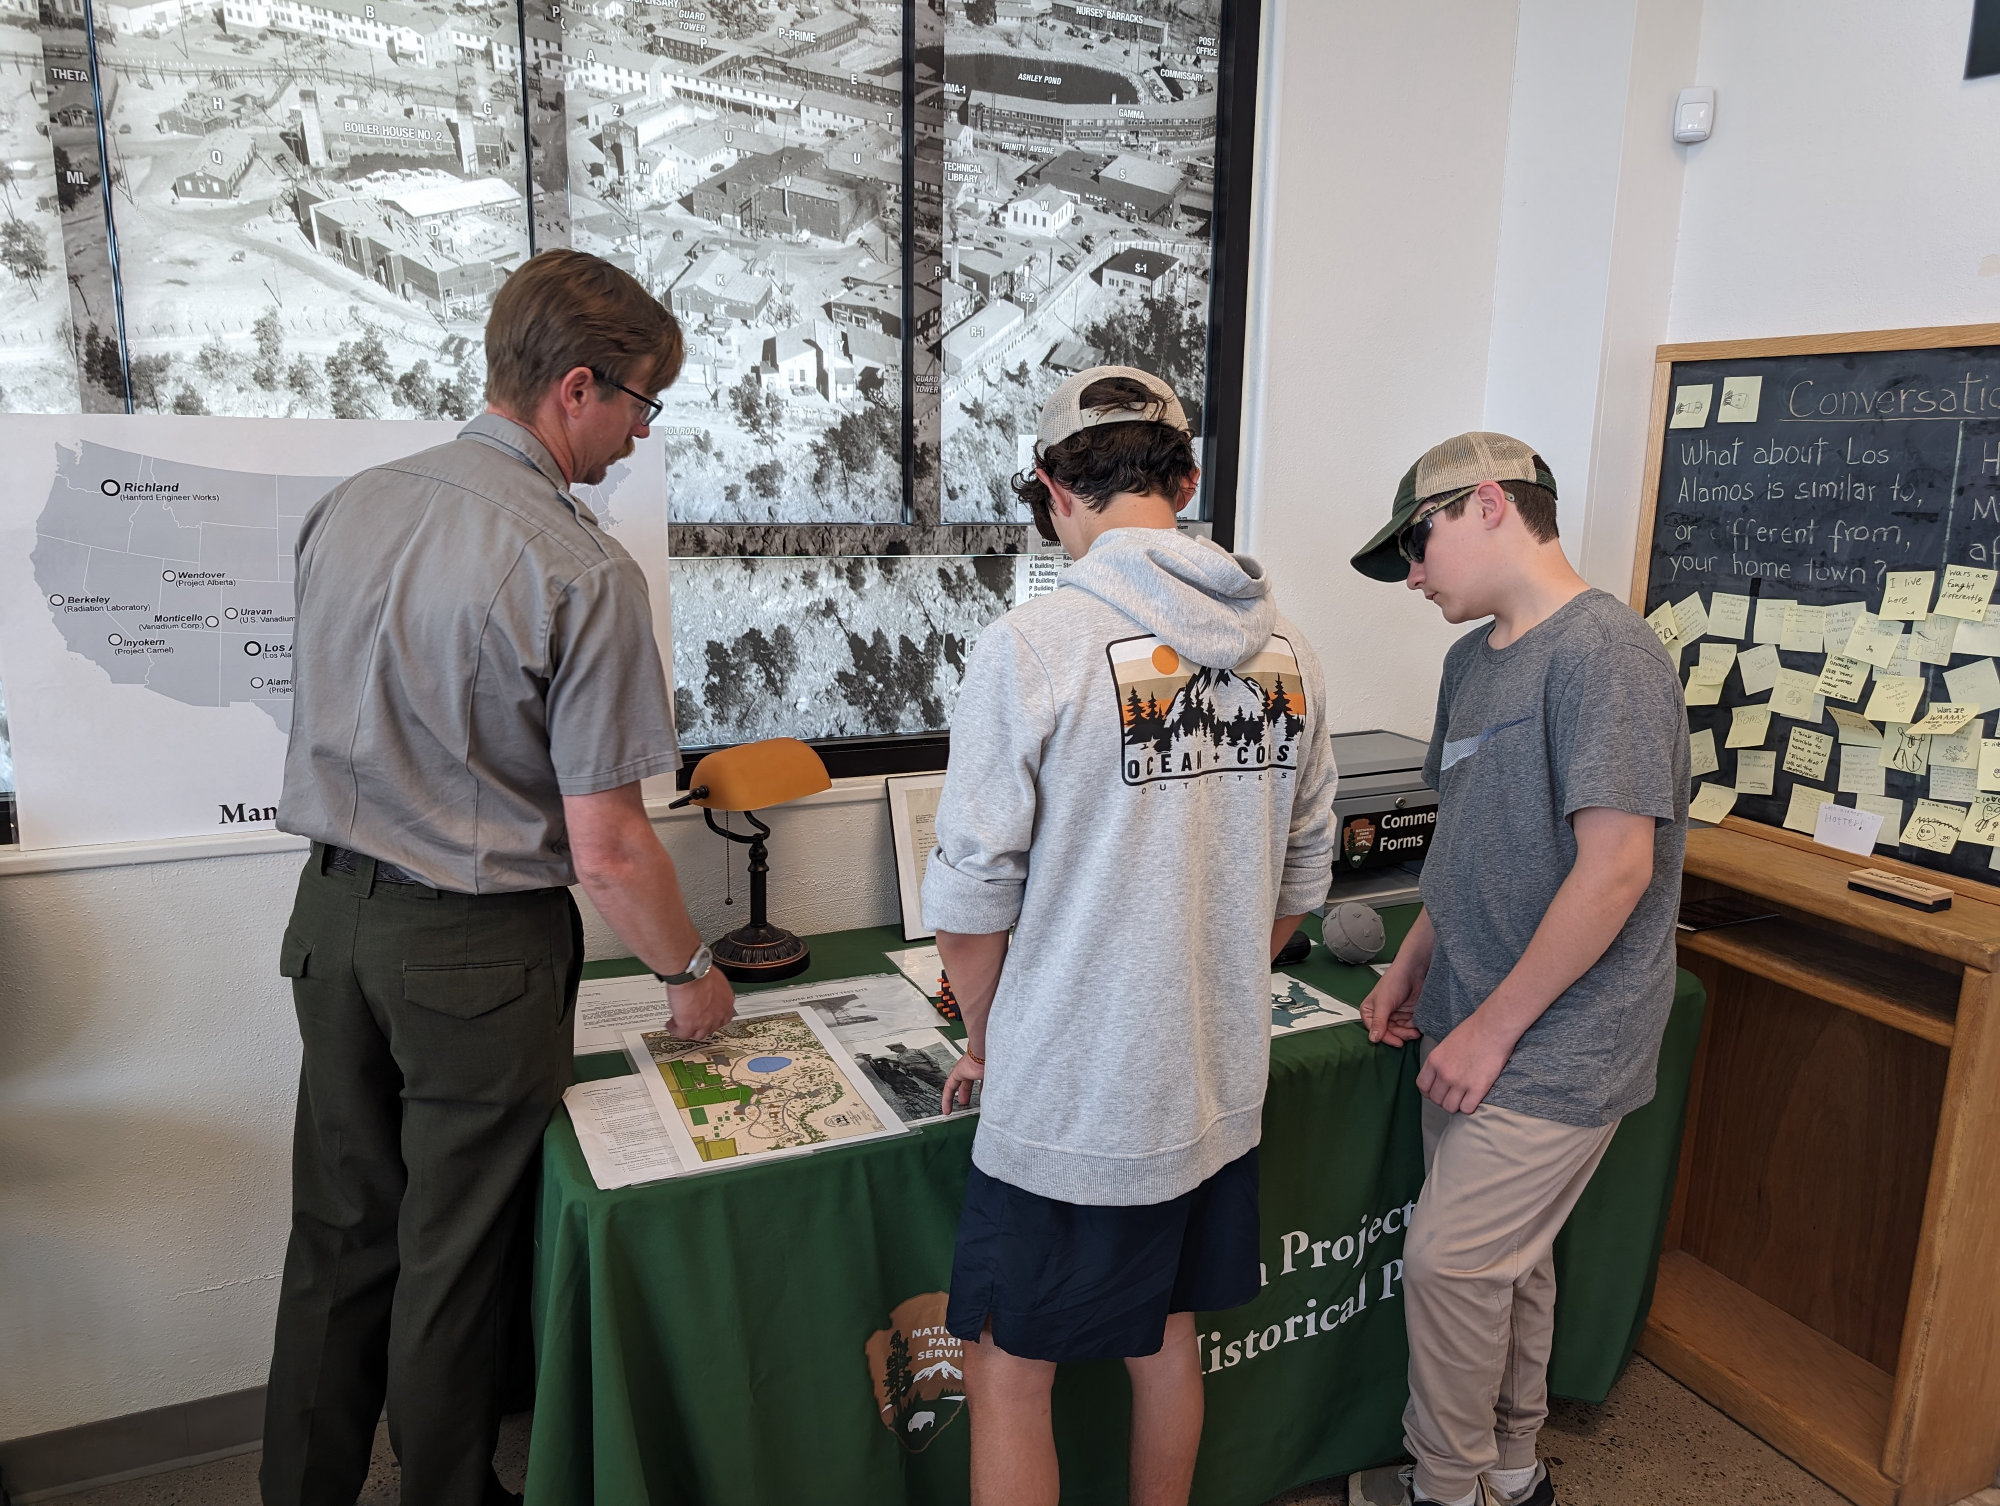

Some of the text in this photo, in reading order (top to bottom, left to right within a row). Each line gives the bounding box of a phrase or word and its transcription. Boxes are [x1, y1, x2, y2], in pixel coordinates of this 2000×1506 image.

[365, 5, 375, 18] B
[678, 9, 706, 21] GUARD
[1076, 5, 1144, 24] NURSES' BARRACKS
[679, 21, 706, 33] TOWER
[778, 27, 817, 43] P-PRIME
[700, 37, 708, 49] P
[1198, 36, 1216, 47] POST
[586, 49, 596, 62] A
[1195, 46, 1218, 57] OFFICE
[50, 67, 89, 82] THETA
[850, 73, 858, 86] E
[1017, 72, 1062, 85] ASHLEY POND
[1160, 68, 1204, 82] COMMISSARY
[212, 96, 223, 110] H
[483, 102, 492, 115] G
[612, 103, 621, 117] Z
[1118, 107, 1145, 119] GAMMA
[886, 112, 893, 124] T
[344, 121, 443, 141] BOILER HOUSE NO. 2
[724, 130, 733, 143] U
[1001, 141, 1056, 155] TRINITY AVENUE
[211, 150, 222, 164] Q
[853, 152, 861, 165] U
[639, 162, 650, 175] M
[943, 161, 983, 174] TECHNICAL
[66, 170, 89, 185] ML
[947, 172, 979, 183] LIBRARY
[1119, 169, 1126, 180] S
[784, 175, 792, 187] V
[1040, 201, 1050, 211] W
[429, 224, 439, 237] D
[934, 266, 942, 277] R
[1134, 263, 1147, 274] S-1
[716, 274, 725, 286] K
[1020, 292, 1035, 303] R-2
[970, 326, 985, 338] R-1
[837, 340, 845, 352] Y
[915, 375, 939, 383] GUARD
[915, 385, 939, 394] TOWER
[677, 427, 701, 436] ROAD
[1681, 437, 1890, 466] What about Los
[124, 482, 179, 493] Richland
[1678, 476, 1754, 504] Alamos
[1767, 473, 1785, 501] is
[1794, 473, 1876, 501] similar
[120, 493, 220, 502] (Hanford Engineer Works)
[1675, 524, 1698, 541] or
[1828, 520, 1911, 552] from,
[1034, 562, 1054, 570] Building
[1670, 555, 1718, 582] your
[1732, 552, 1791, 579] home
[178, 571, 226, 579] Wendover
[1038, 570, 1058, 578] Building
[175, 578, 236, 588] (Project Alberta)
[1035, 577, 1055, 585] Building
[1889, 576, 1922, 589] I live
[1946, 579, 1975, 592] fought
[67, 596, 110, 605] Berkeley
[1887, 596, 1909, 605] here
[1941, 592, 1984, 604] differently
[64, 603, 150, 613] (Radiation Laboratory)
[240, 608, 273, 616] Uravan
[154, 613, 203, 623] Monticello
[239, 616, 259, 625] (U.S.
[138, 622, 205, 631] (Vanadium Corp.)
[123, 637, 165, 648] Inyokern
[264, 643, 286, 652] Los
[114, 645, 174, 656] (Project Camel)
[262, 652, 278, 660] (Los
[1236, 744, 1290, 765] COS
[1974, 795, 1981, 804] I
[1379, 833, 1424, 851] Forms
[1280, 1199, 1417, 1276] Project
